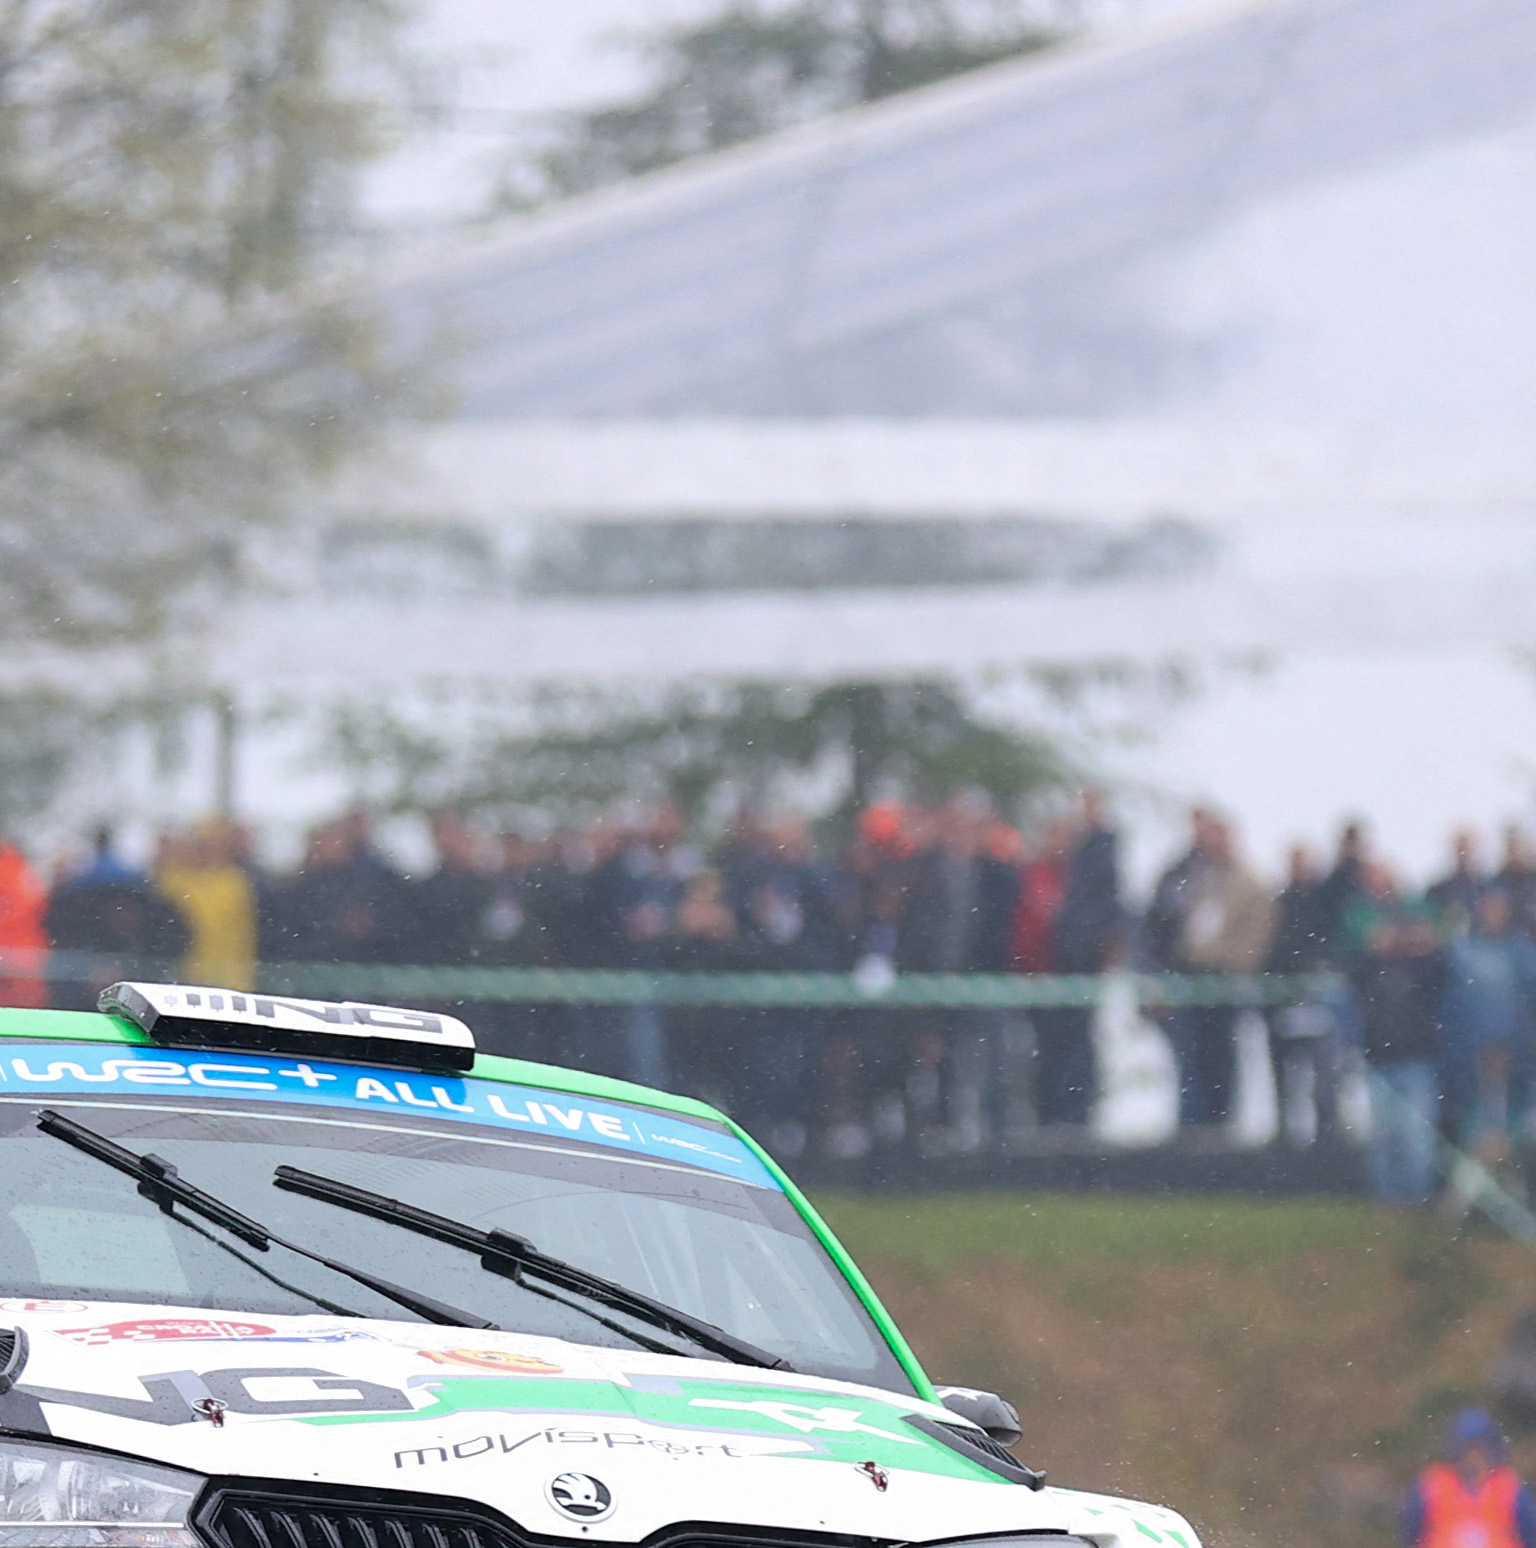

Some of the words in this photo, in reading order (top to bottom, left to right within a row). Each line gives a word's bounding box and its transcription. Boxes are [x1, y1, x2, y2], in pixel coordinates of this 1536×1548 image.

[355, 1078, 474, 1113] ALL
[487, 1094, 630, 1140] LIVE
[393, 1426, 745, 1468] movisport
